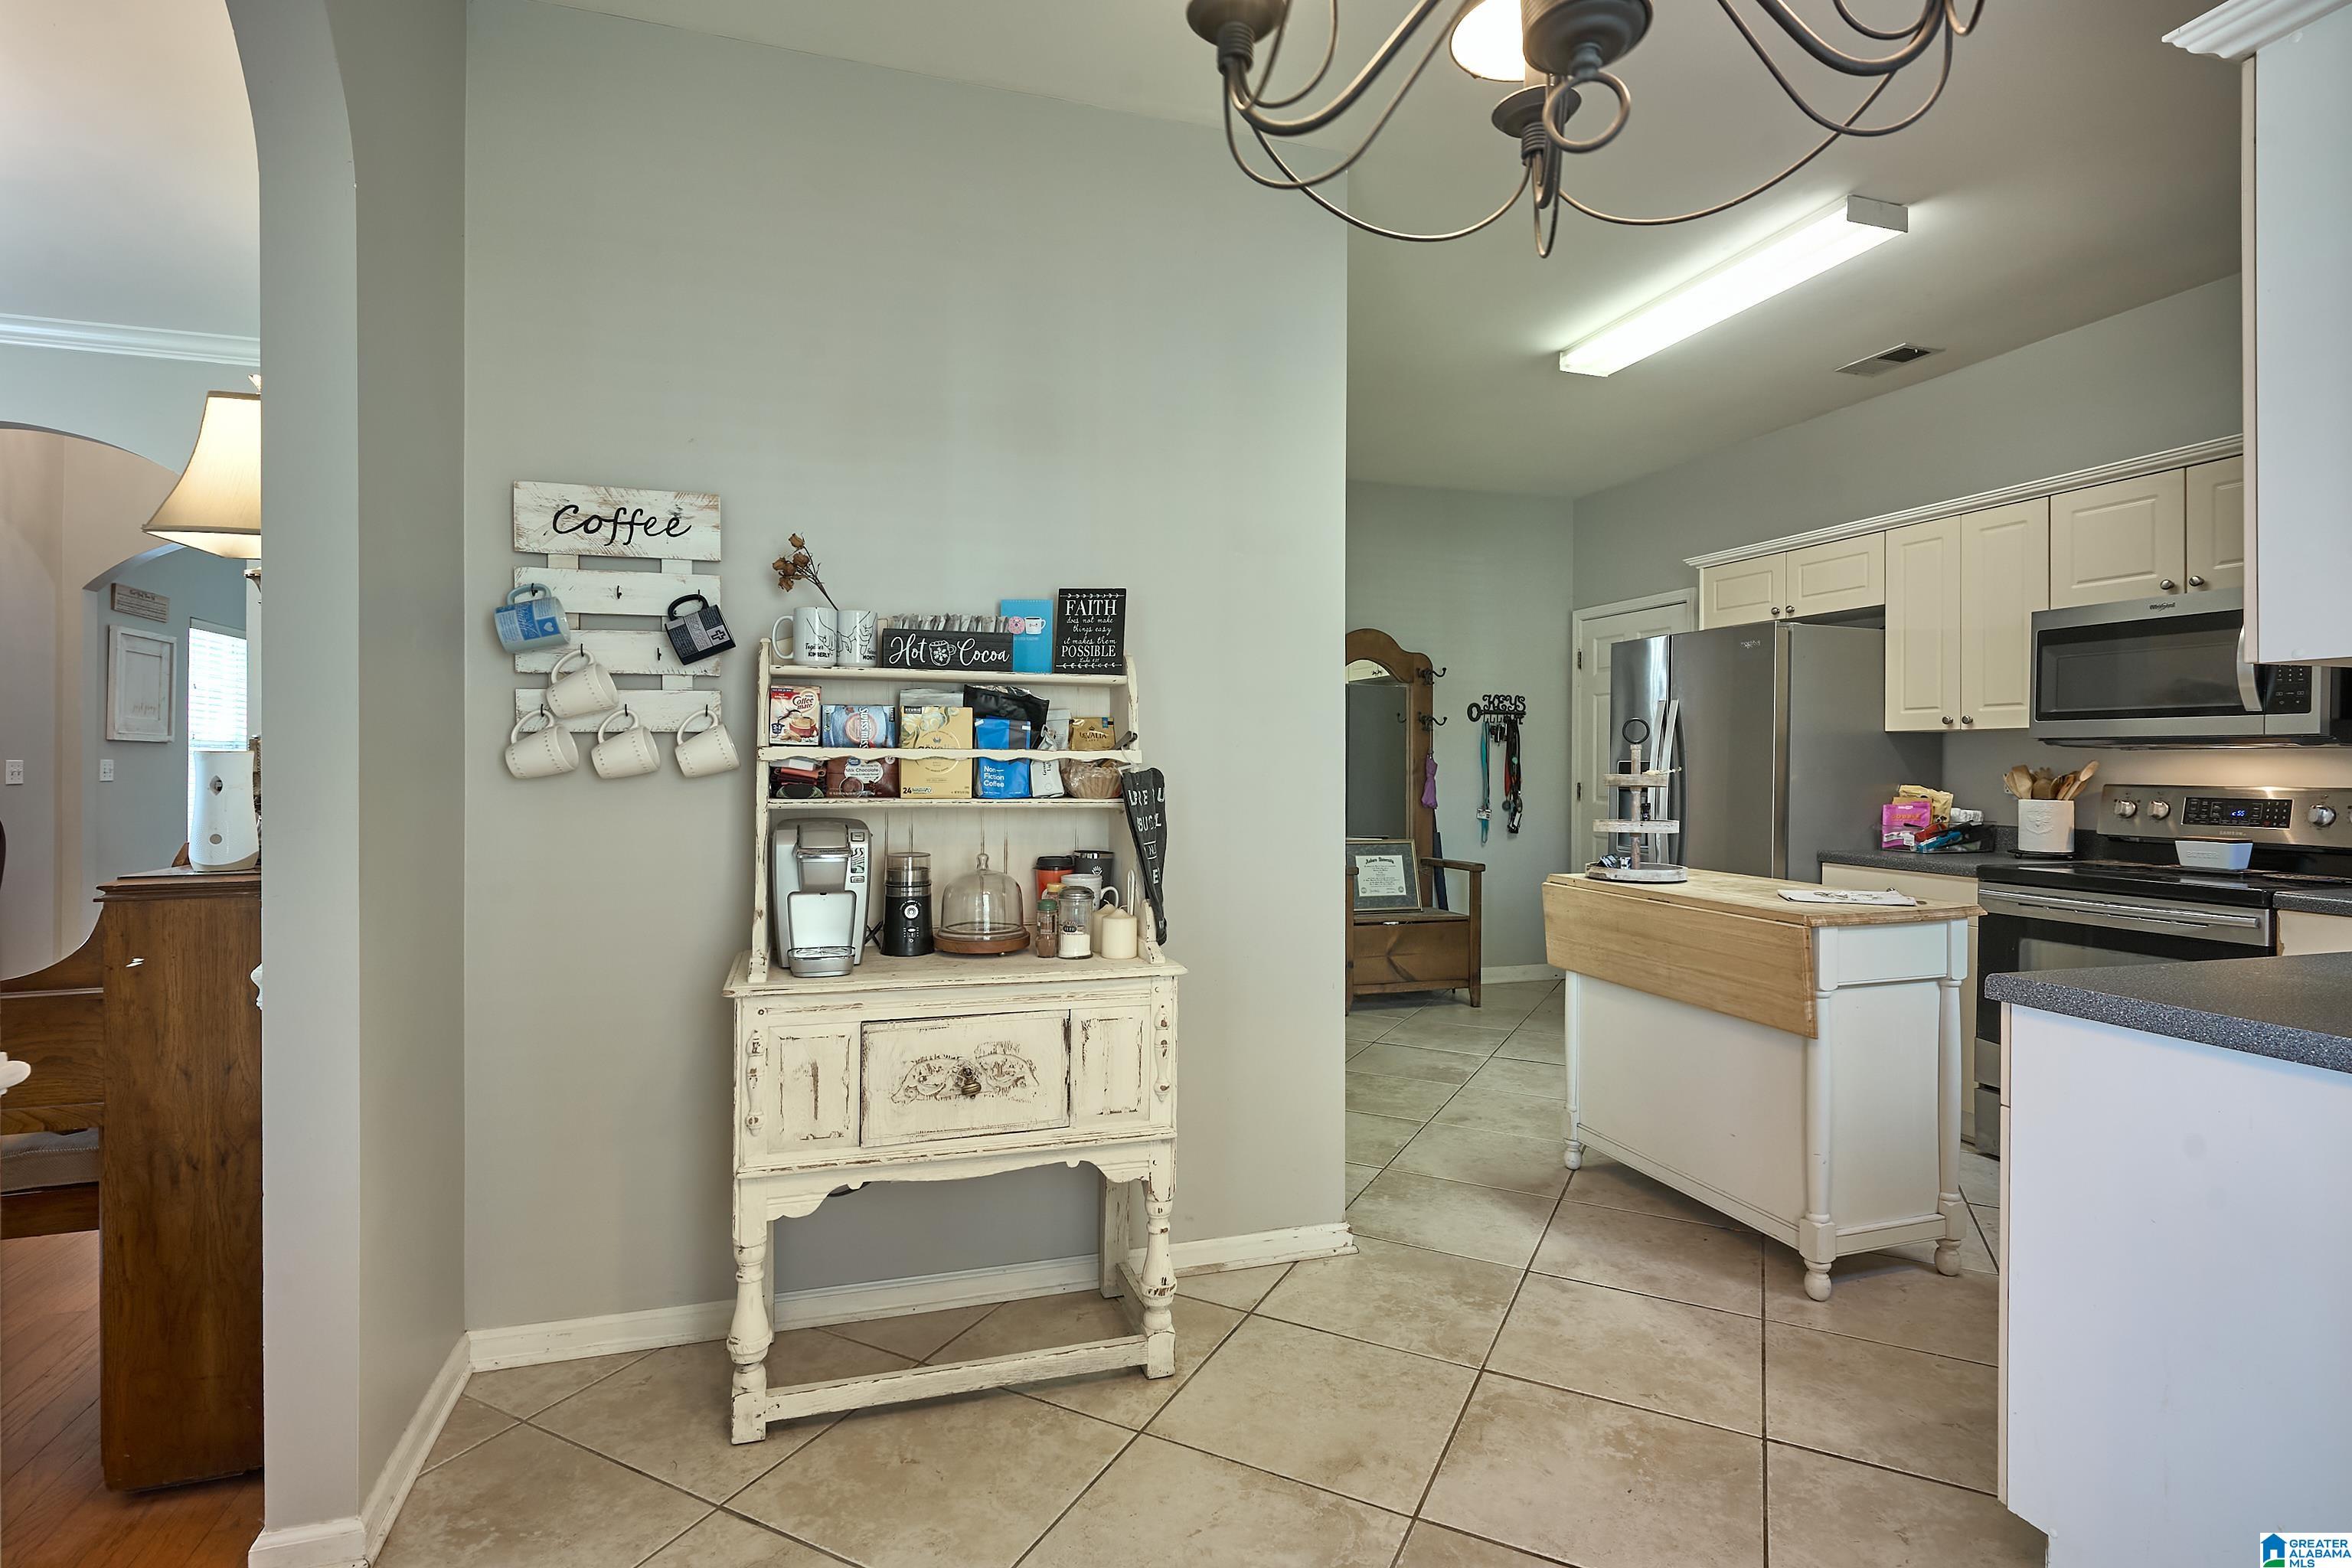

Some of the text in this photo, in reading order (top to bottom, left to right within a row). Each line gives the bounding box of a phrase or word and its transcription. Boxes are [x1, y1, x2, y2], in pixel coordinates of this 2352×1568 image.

[552, 504, 692, 547] Coffee
[1065, 599, 1117, 616] FAITH
[1097, 615, 1114, 623] make
[1073, 624, 1112, 635] things easy
[1073, 635, 1095, 645] makes
[1096, 635, 1117, 645] them
[889, 633, 1010, 666] Hot Cocoa
[1061, 645, 1116, 658] POSSIBLE
[792, 696, 814, 706] Coffee
[1481, 694, 1526, 712] KEYS
[984, 773, 1004, 781] Fiction
[983, 779, 1004, 788] Coffee
